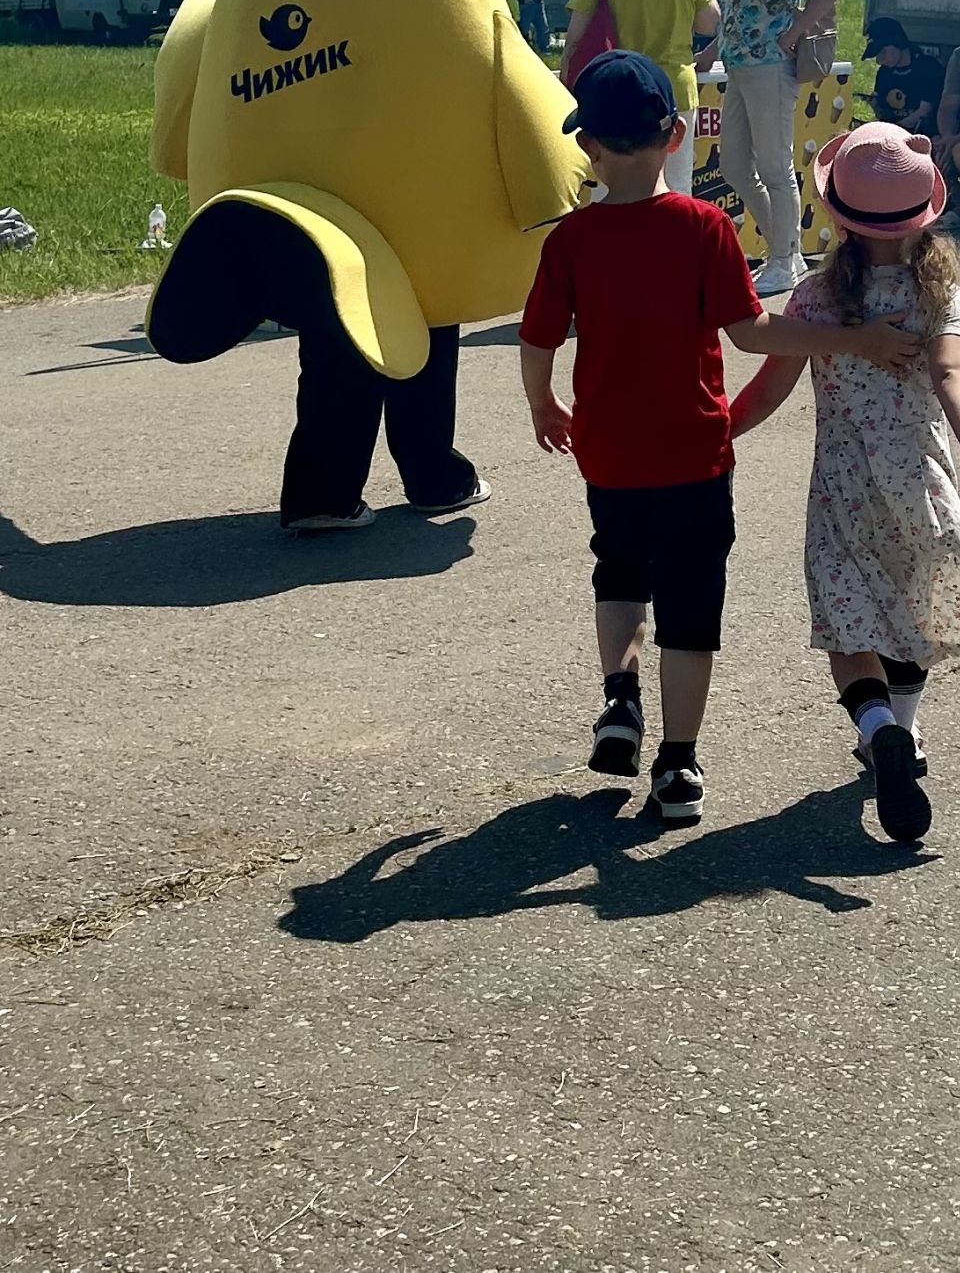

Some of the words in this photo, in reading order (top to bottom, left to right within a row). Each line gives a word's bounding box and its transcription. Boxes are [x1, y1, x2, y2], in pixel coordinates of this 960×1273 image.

[231, 40, 352, 103] Чижик
[694, 107, 721, 138] ЕВ
[711, 190, 740, 210] ОЕ!
